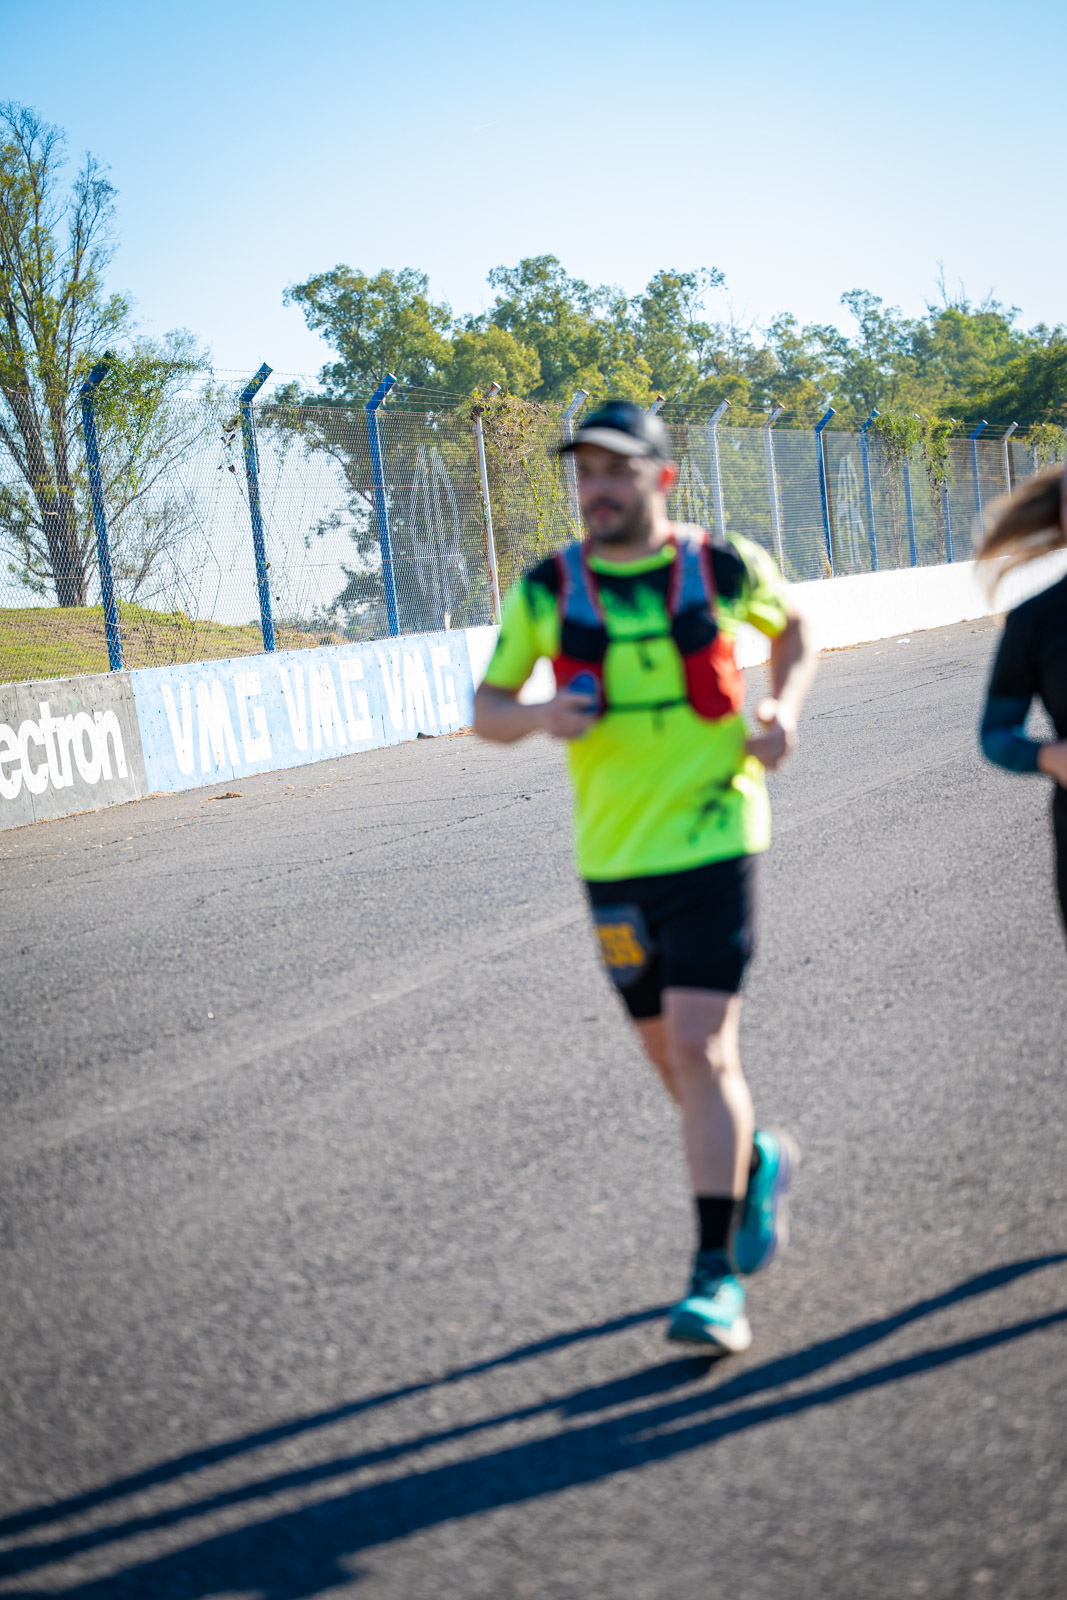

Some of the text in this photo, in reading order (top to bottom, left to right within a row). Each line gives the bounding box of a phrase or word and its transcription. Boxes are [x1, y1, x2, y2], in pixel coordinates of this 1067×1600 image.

[0, 702, 128, 799] ectron
[161, 647, 459, 775] VMG VMG VMG
